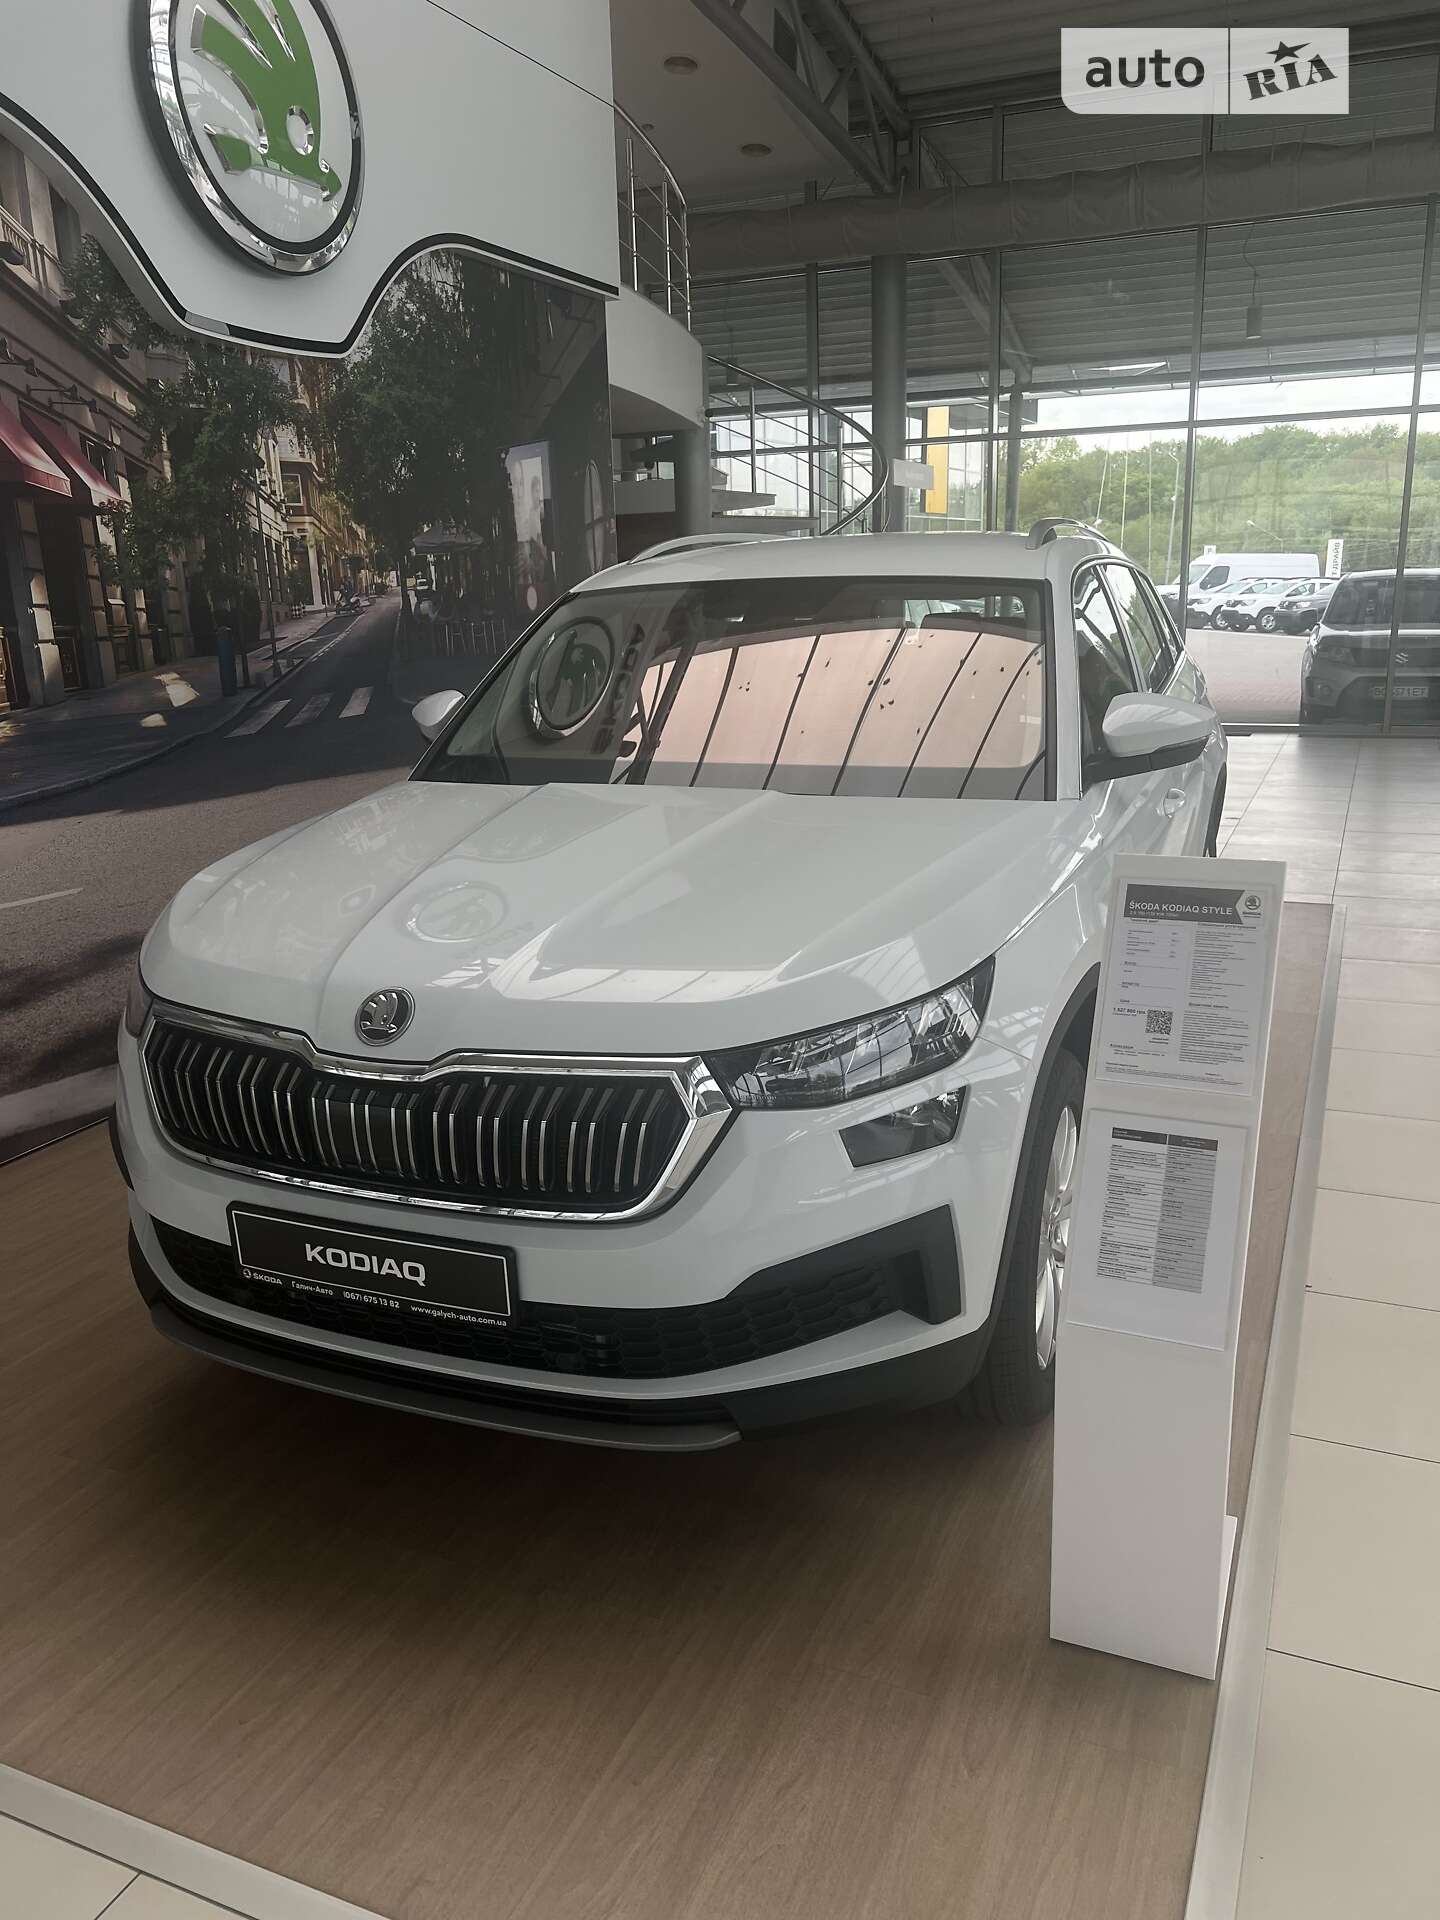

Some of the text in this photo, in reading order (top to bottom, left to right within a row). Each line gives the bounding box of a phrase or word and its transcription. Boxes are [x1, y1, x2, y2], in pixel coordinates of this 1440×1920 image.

[1129, 900, 1160, 912] ŠKODA
[1161, 903, 1200, 915] KODIAQ
[1201, 905, 1233, 916] STYLE
[305, 1243, 426, 1287] KODIAQ
[291, 1281, 334, 1296] Галич-Авто
[363, 1294, 378, 1305] 675
[379, 1297, 388, 1307] 13
[410, 1304, 507, 1327] www.galych-auto.com.ua
